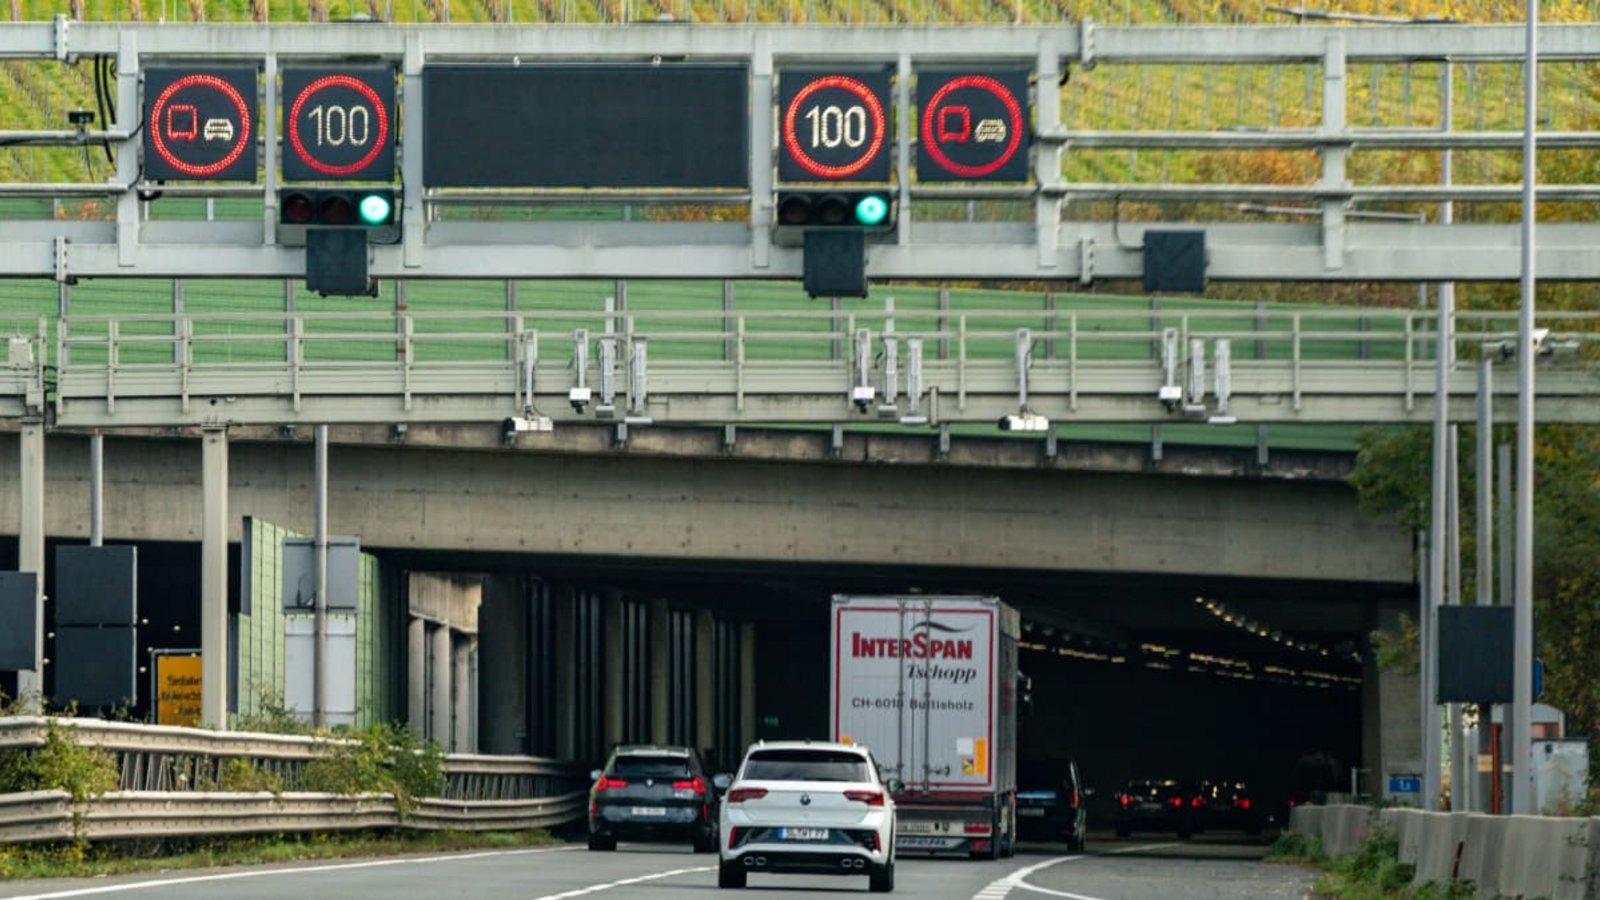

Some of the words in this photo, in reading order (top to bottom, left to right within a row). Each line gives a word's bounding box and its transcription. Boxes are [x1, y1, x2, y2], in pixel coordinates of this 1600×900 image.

[308, 105, 369, 146] 100
[805, 105, 867, 148] 100
[906, 664, 977, 685] Tschopp
